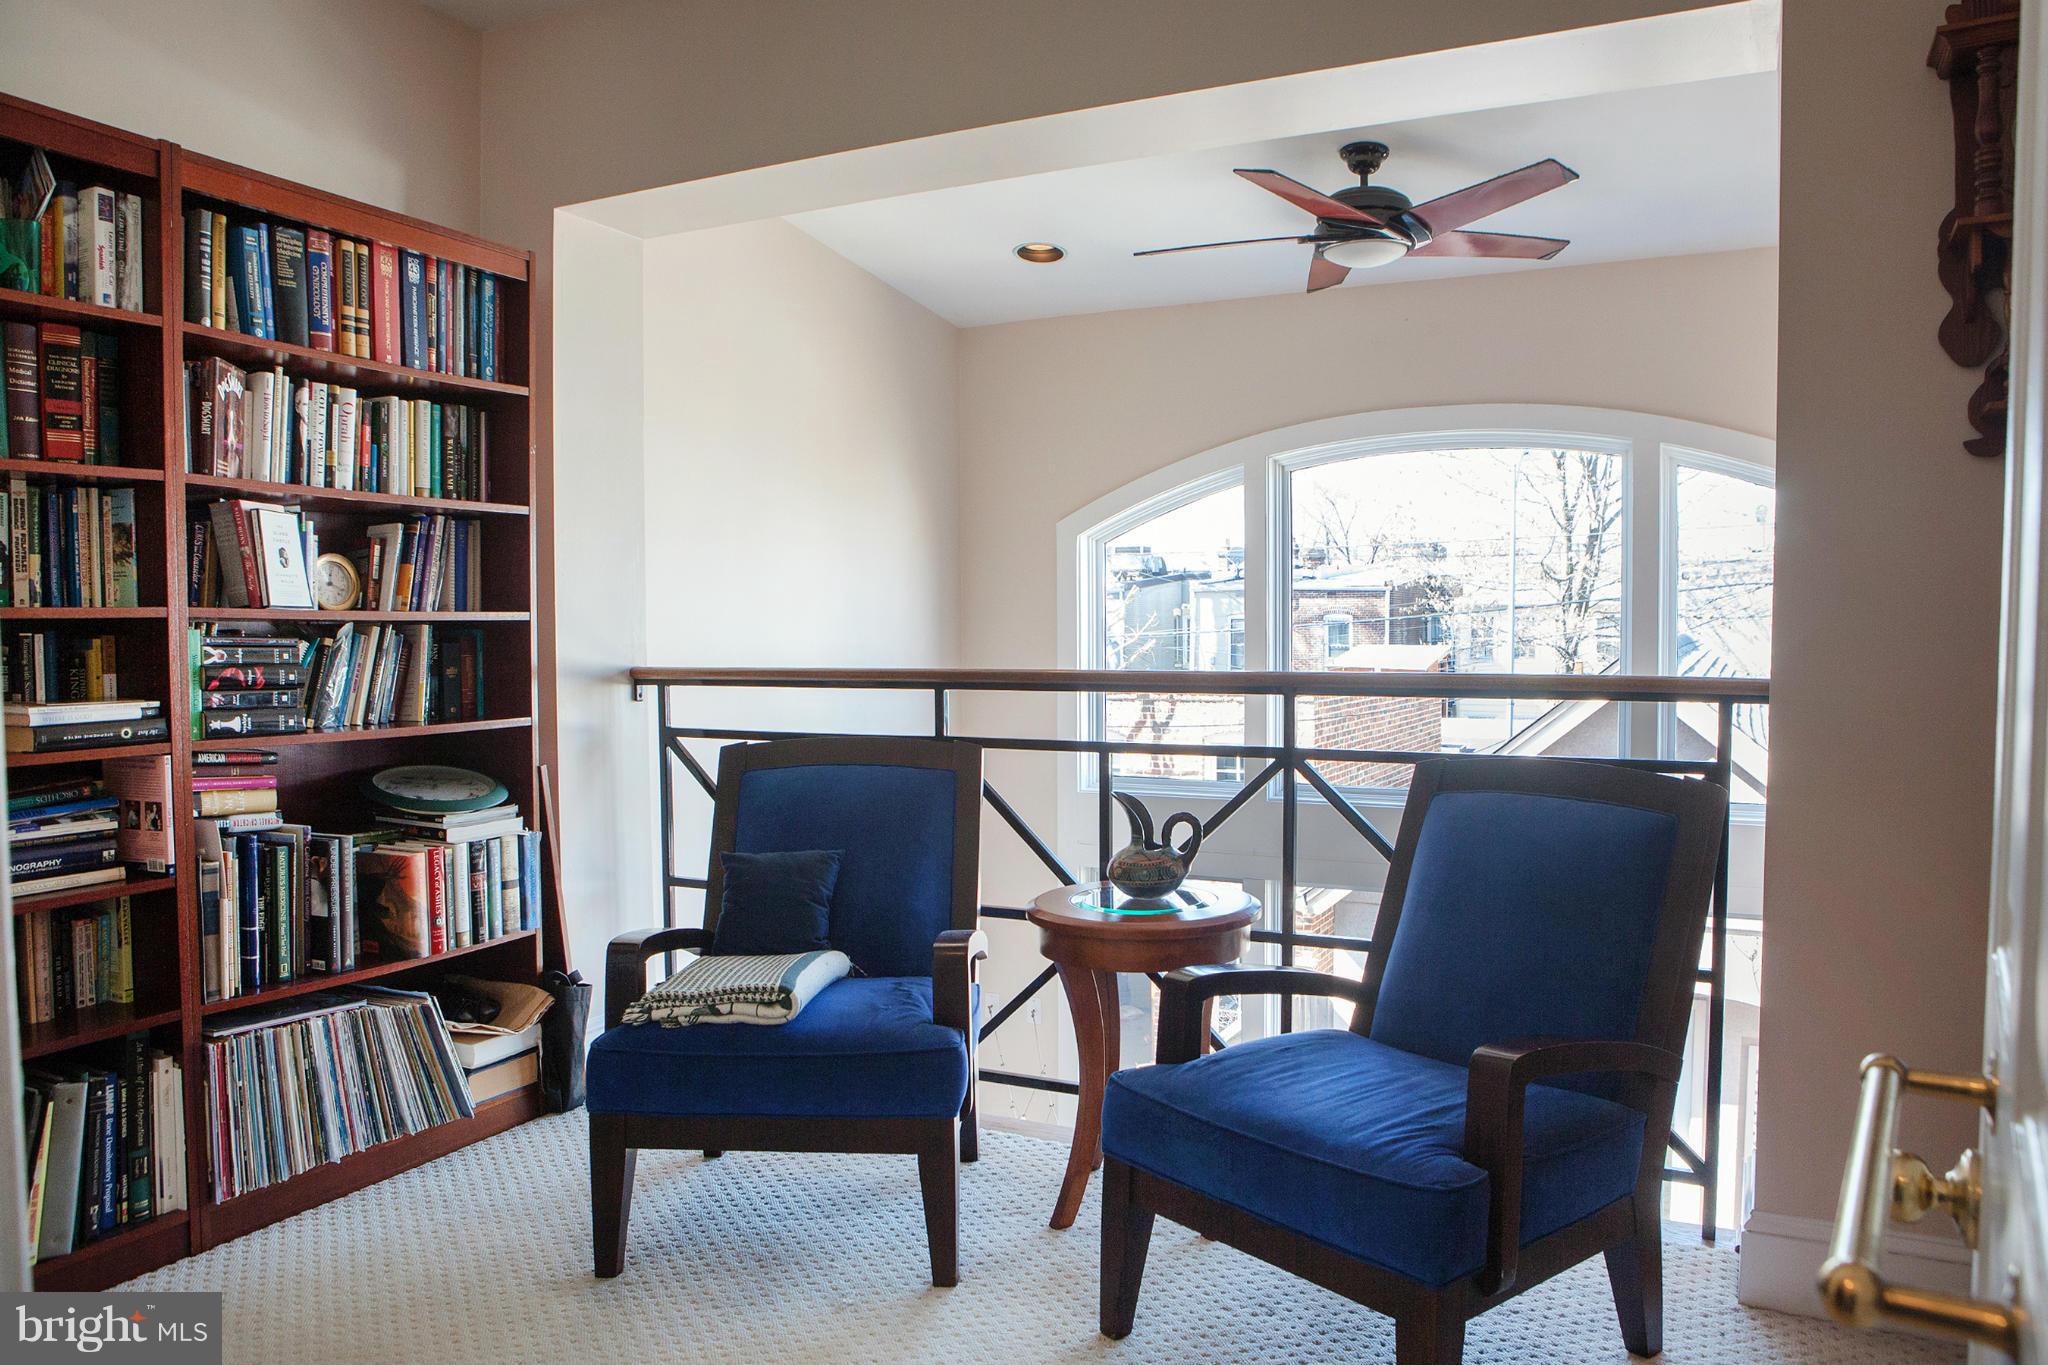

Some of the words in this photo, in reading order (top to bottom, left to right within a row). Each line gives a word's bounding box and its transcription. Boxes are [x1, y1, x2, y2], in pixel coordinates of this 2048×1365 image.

[276, 235, 302, 246] Principles
[97, 244, 105, 271] Spanish
[276, 248, 302, 258] Medicine
[343, 252, 352, 305] PATHOLOGY
[360, 255, 368, 307] PATHOLOGY
[312, 265, 321, 319] GYNECOLOGY
[320, 262, 329, 326] COMPREHENSIVE
[9, 367, 32, 376] Medical
[47, 366, 80, 374] DIAGNOSIS
[48, 360, 78, 368] CLINICAL
[9, 378, 37, 387] Dictionar
[260, 420, 269, 433] Say
[340, 402, 354, 443] Oprah
[70, 669, 79, 699] KING
[198, 753, 225, 763] AMERICAN
[36, 790, 79, 804] ORCHIDS
[10, 859, 62, 872] NOGRAPHY
[135, 1076, 144, 1084] of
[106, 1084, 114, 1115] LUNAR
[135, 1109, 144, 1146] Operations
[104, 1136, 113, 1183] Densitometry
[104, 1183, 113, 1213] Proposal
